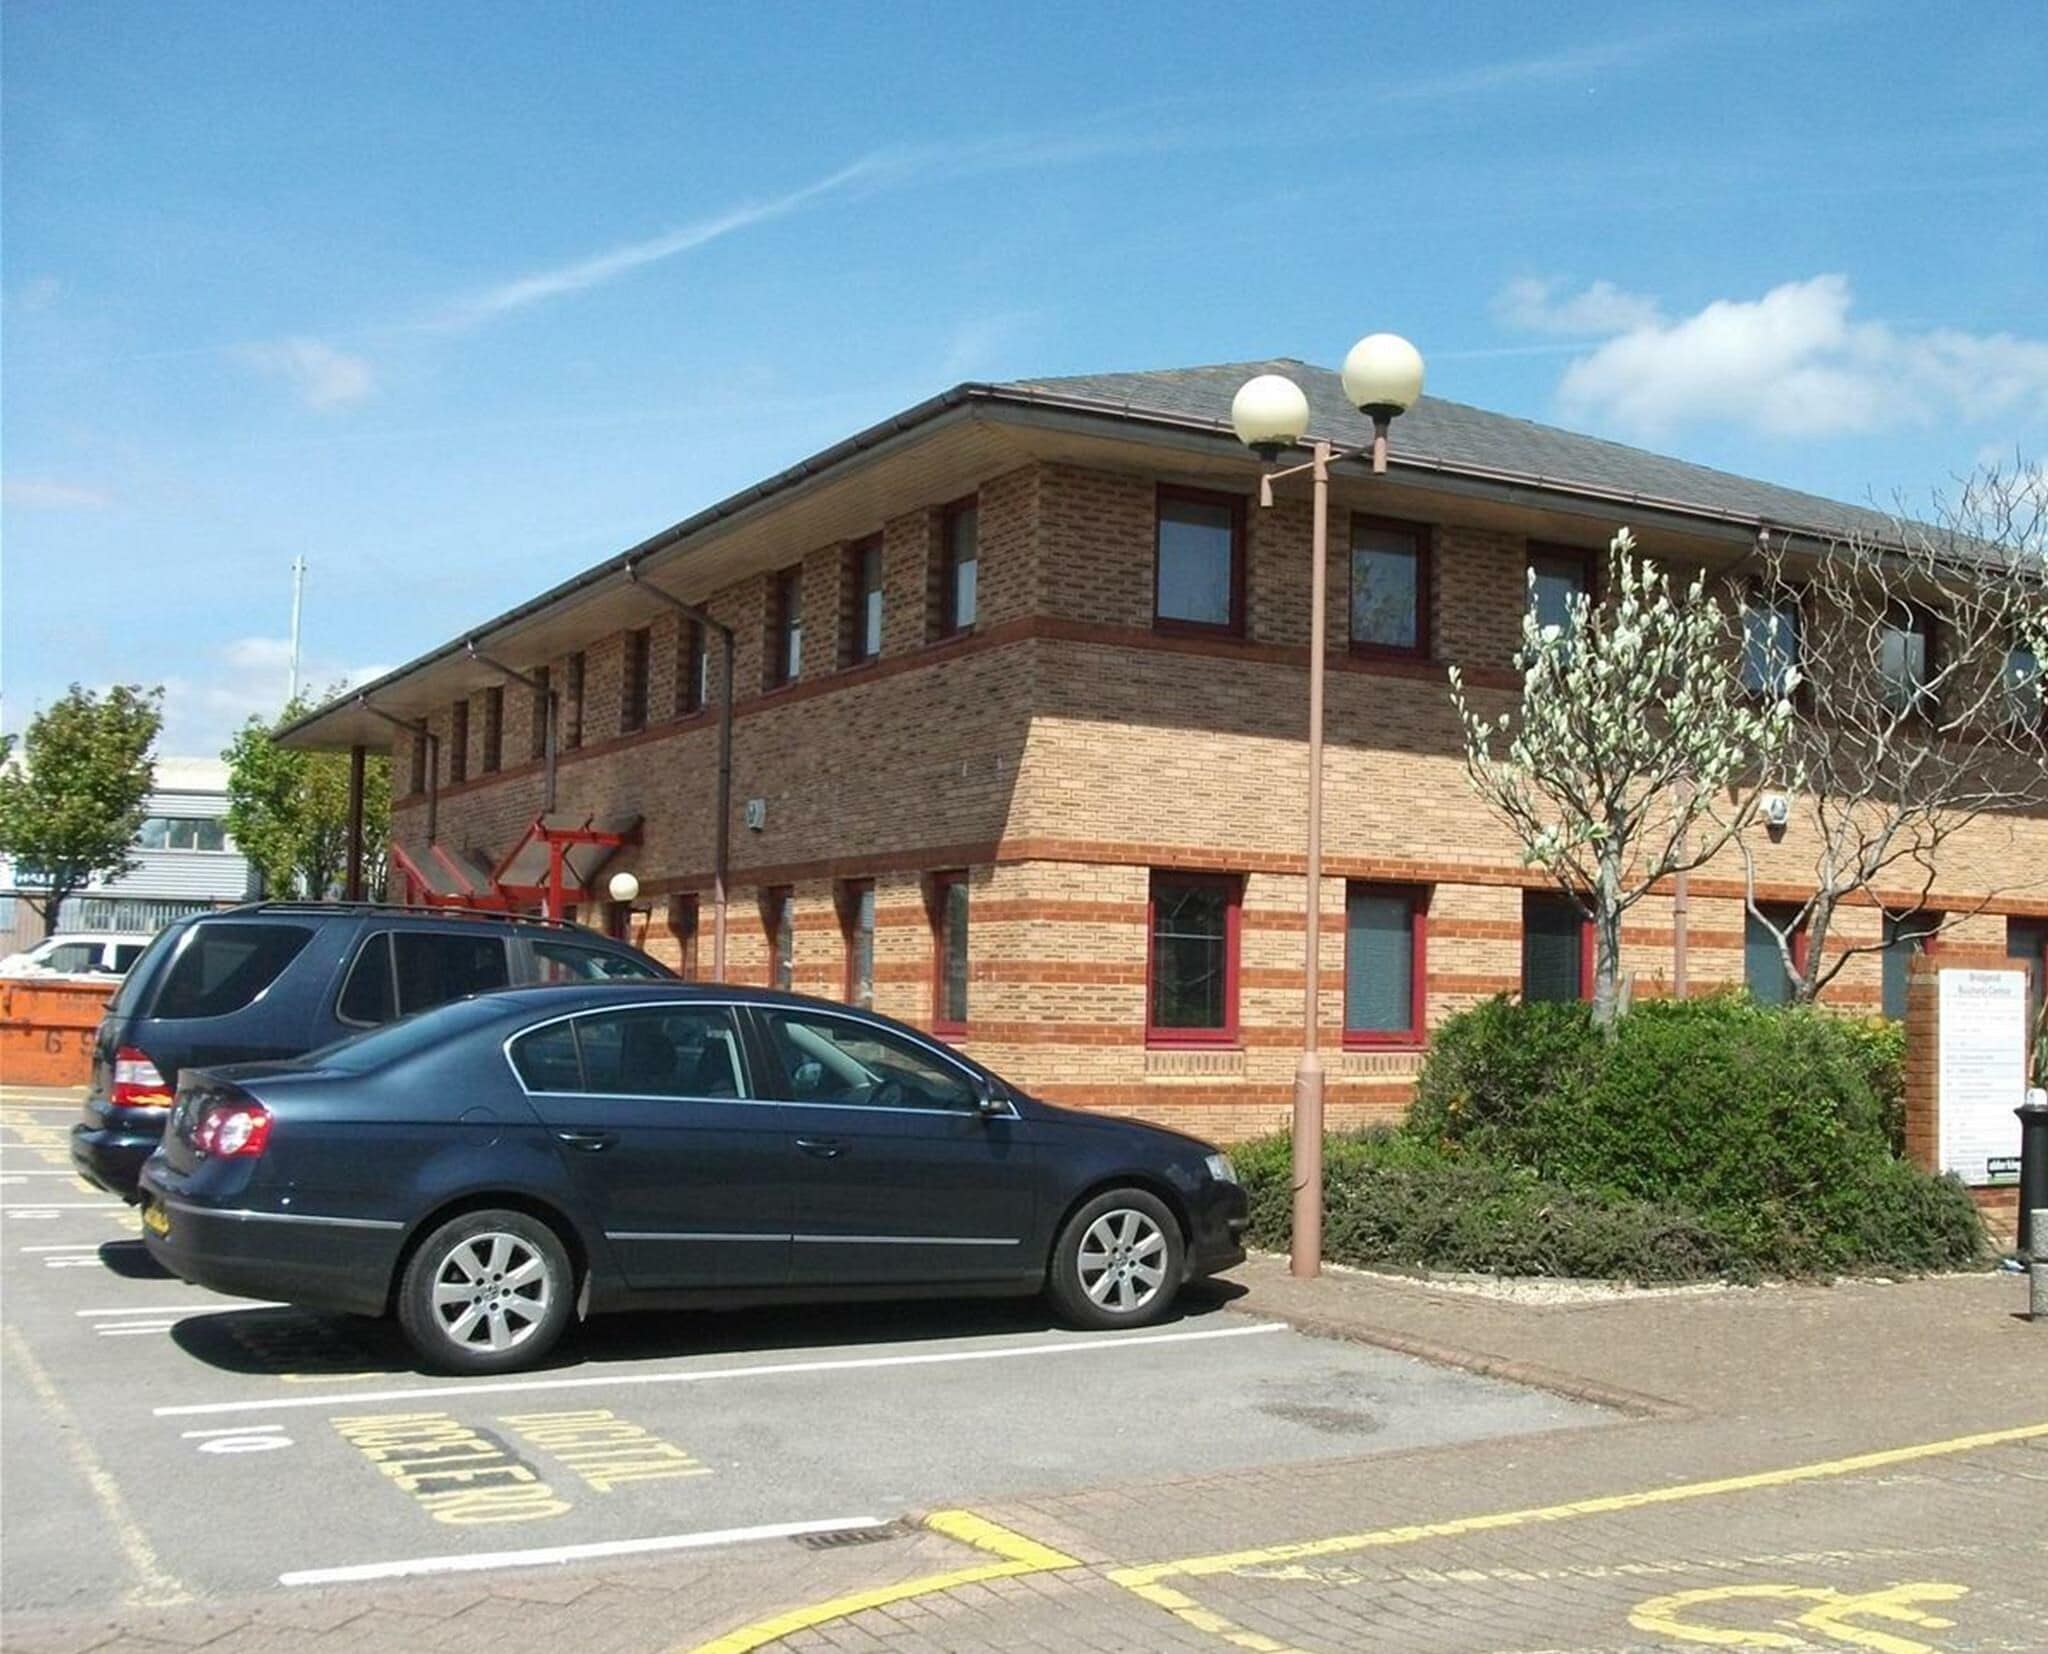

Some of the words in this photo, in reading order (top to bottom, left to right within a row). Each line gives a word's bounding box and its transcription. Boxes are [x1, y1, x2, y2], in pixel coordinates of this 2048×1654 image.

[181, 1424, 295, 1454] 10
[328, 1412, 576, 1524] ACCELERO
[498, 1409, 714, 1493] DIGITAL
